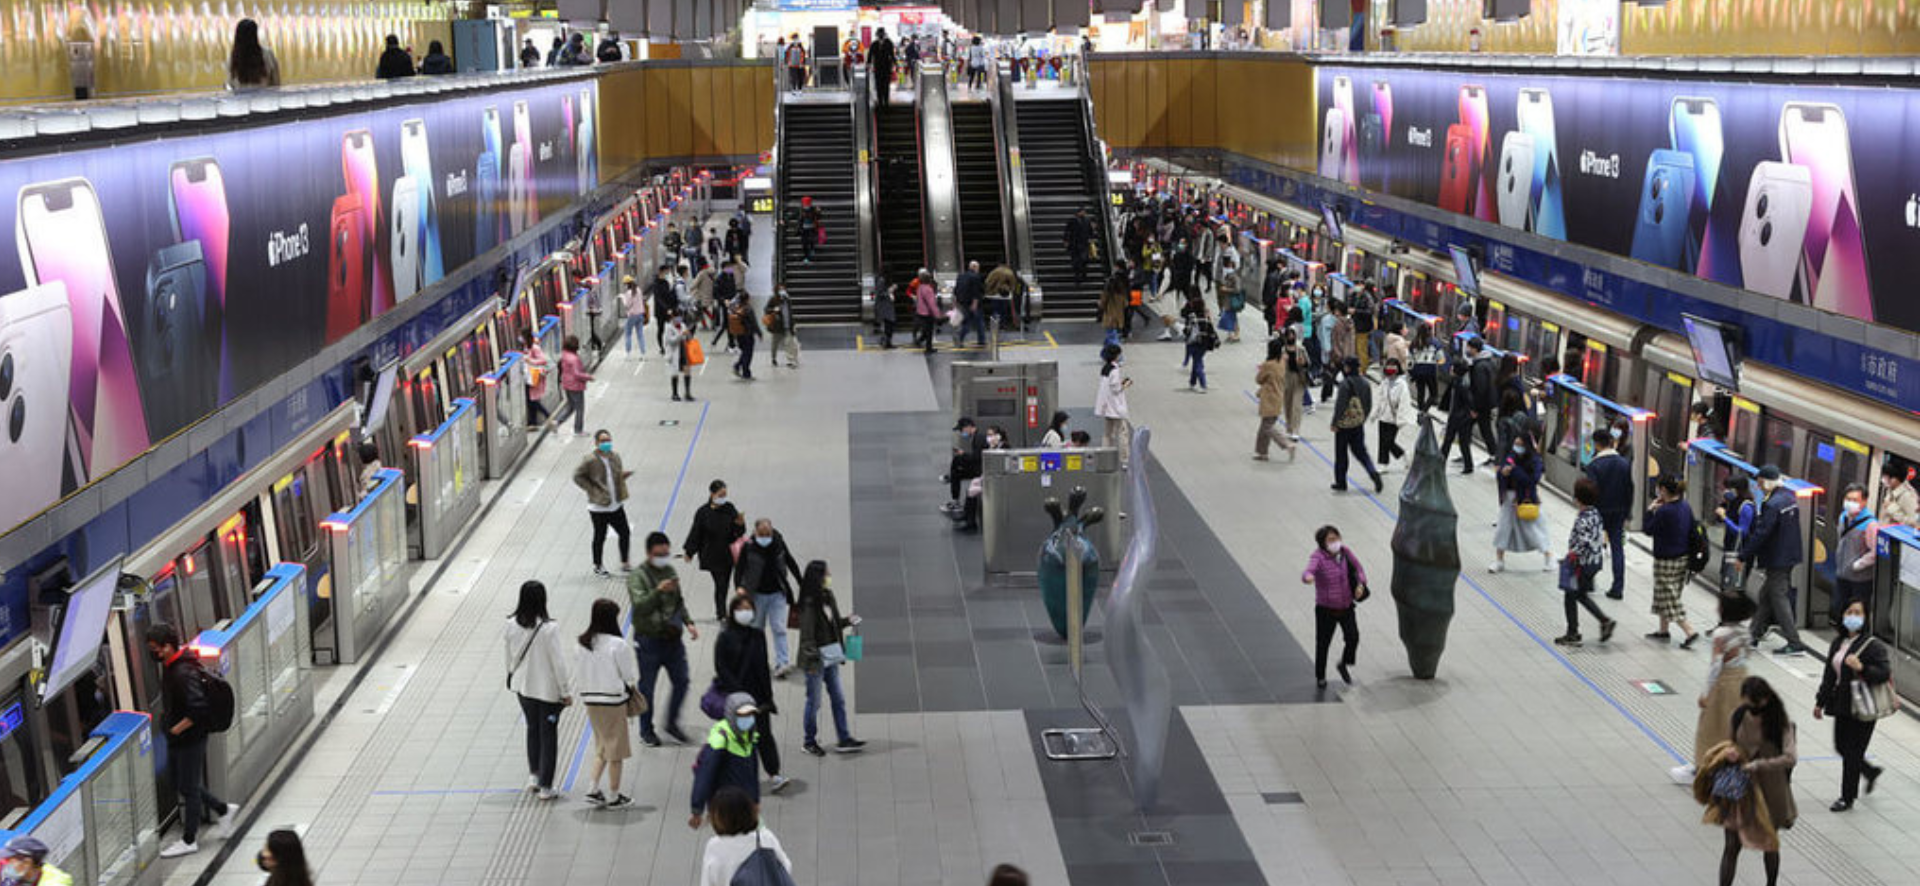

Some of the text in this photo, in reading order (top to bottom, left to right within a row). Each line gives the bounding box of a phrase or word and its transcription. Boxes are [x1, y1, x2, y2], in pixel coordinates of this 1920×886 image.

[1586, 151, 1620, 179] iPhone 13
[274, 222, 309, 264] iPhone 13
